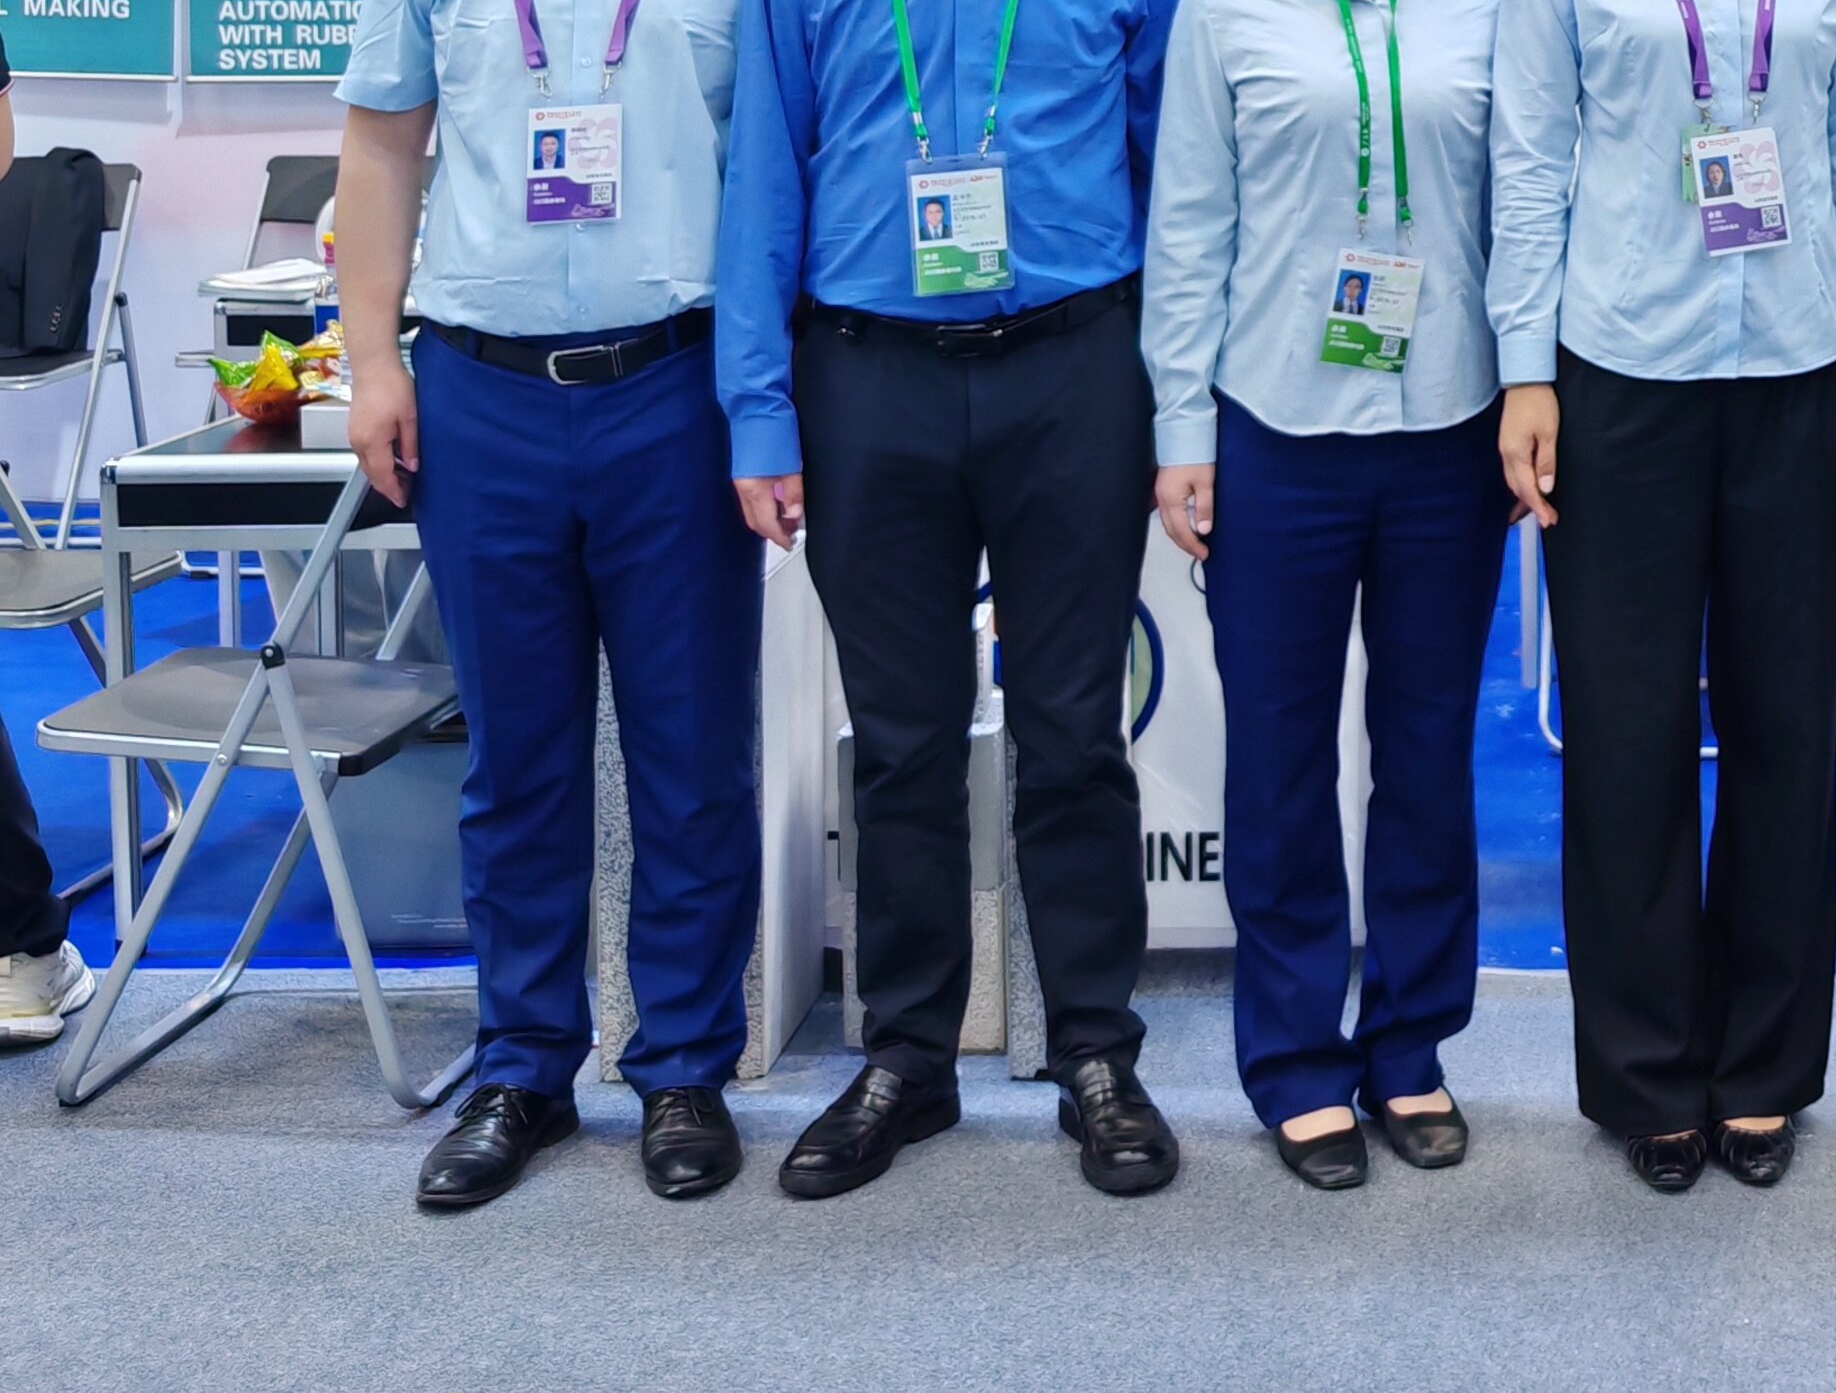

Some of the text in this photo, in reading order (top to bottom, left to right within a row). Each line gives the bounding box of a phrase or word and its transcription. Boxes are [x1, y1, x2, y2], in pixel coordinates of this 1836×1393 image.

[219, 25, 358, 46] WITH RUB
[218, 49, 322, 71] SYSTEM
